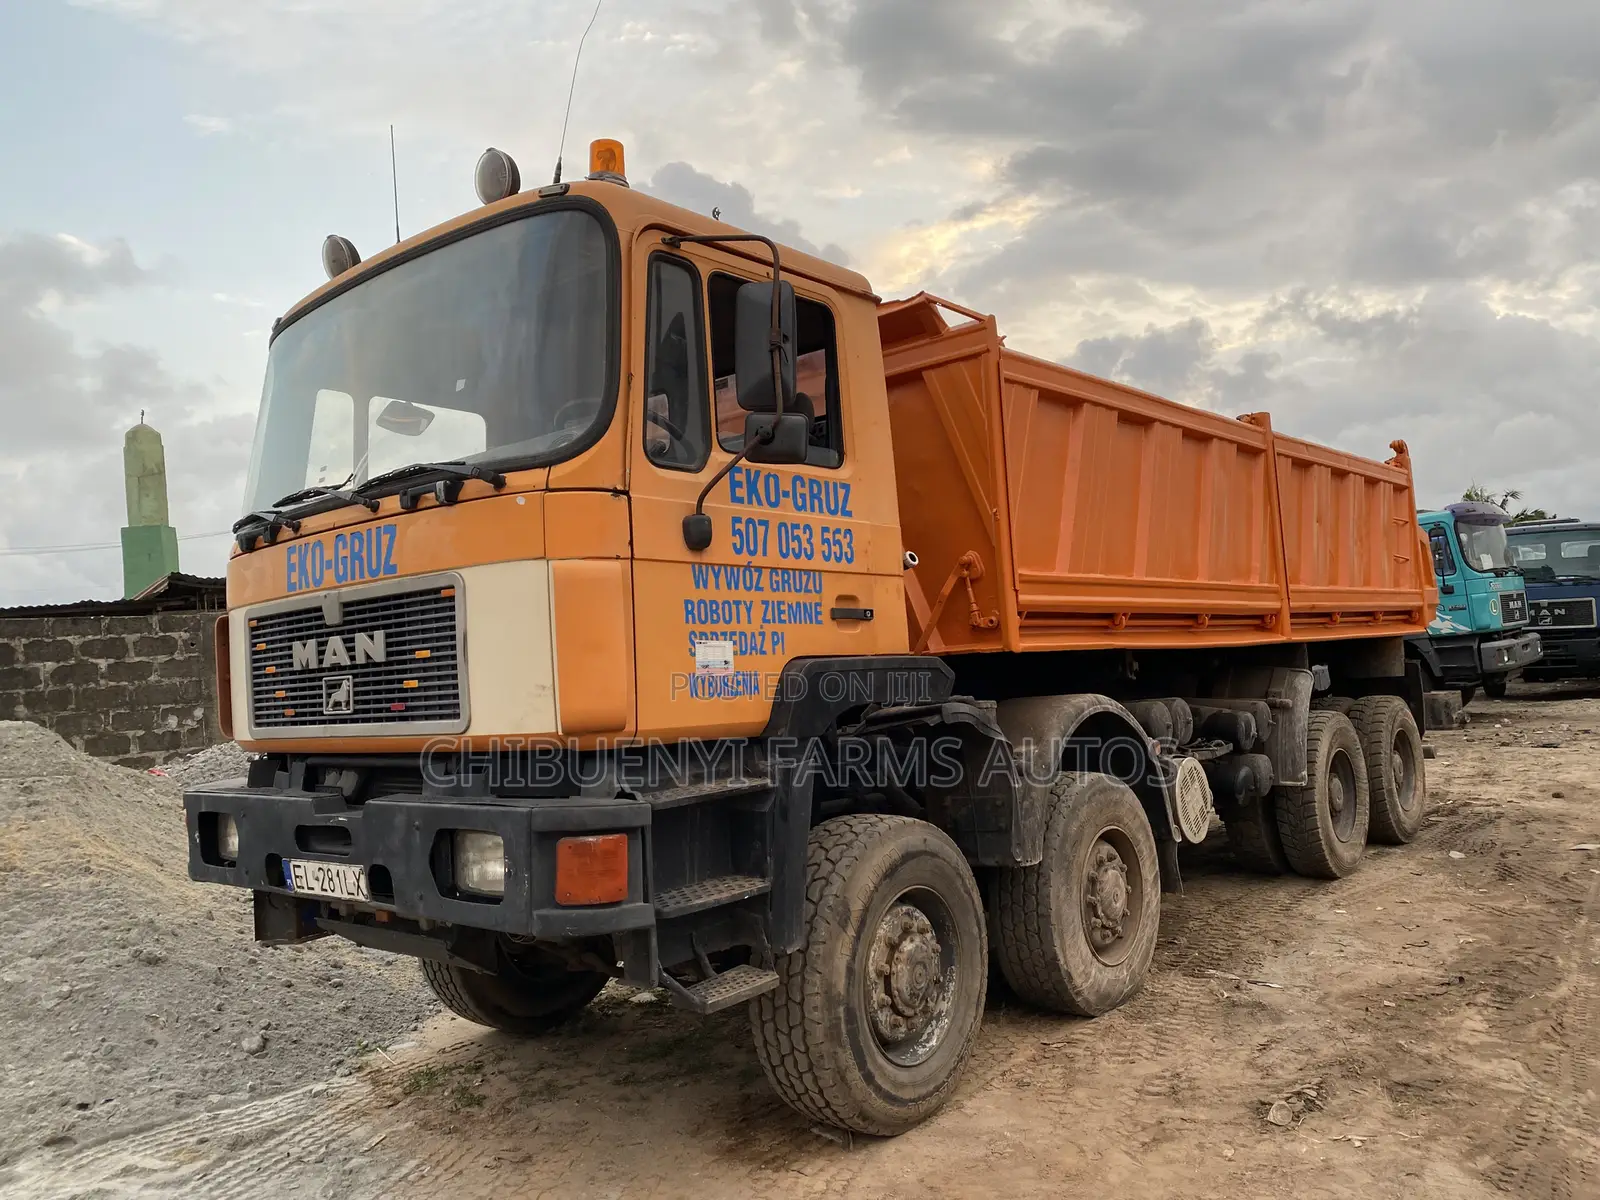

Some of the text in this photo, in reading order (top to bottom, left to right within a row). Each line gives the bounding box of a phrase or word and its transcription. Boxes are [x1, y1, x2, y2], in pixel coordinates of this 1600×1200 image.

[729, 466, 853, 518] EKO-GRUZ
[286, 524, 398, 593] EKO-GRUZ
[731, 516, 855, 565] 507 053 553
[691, 561, 823, 595] WYWÓZ GRUZU
[684, 599, 823, 626] ROBOTY ZIEMNE
[292, 629, 387, 671] MAN
[293, 864, 315, 891] EL
